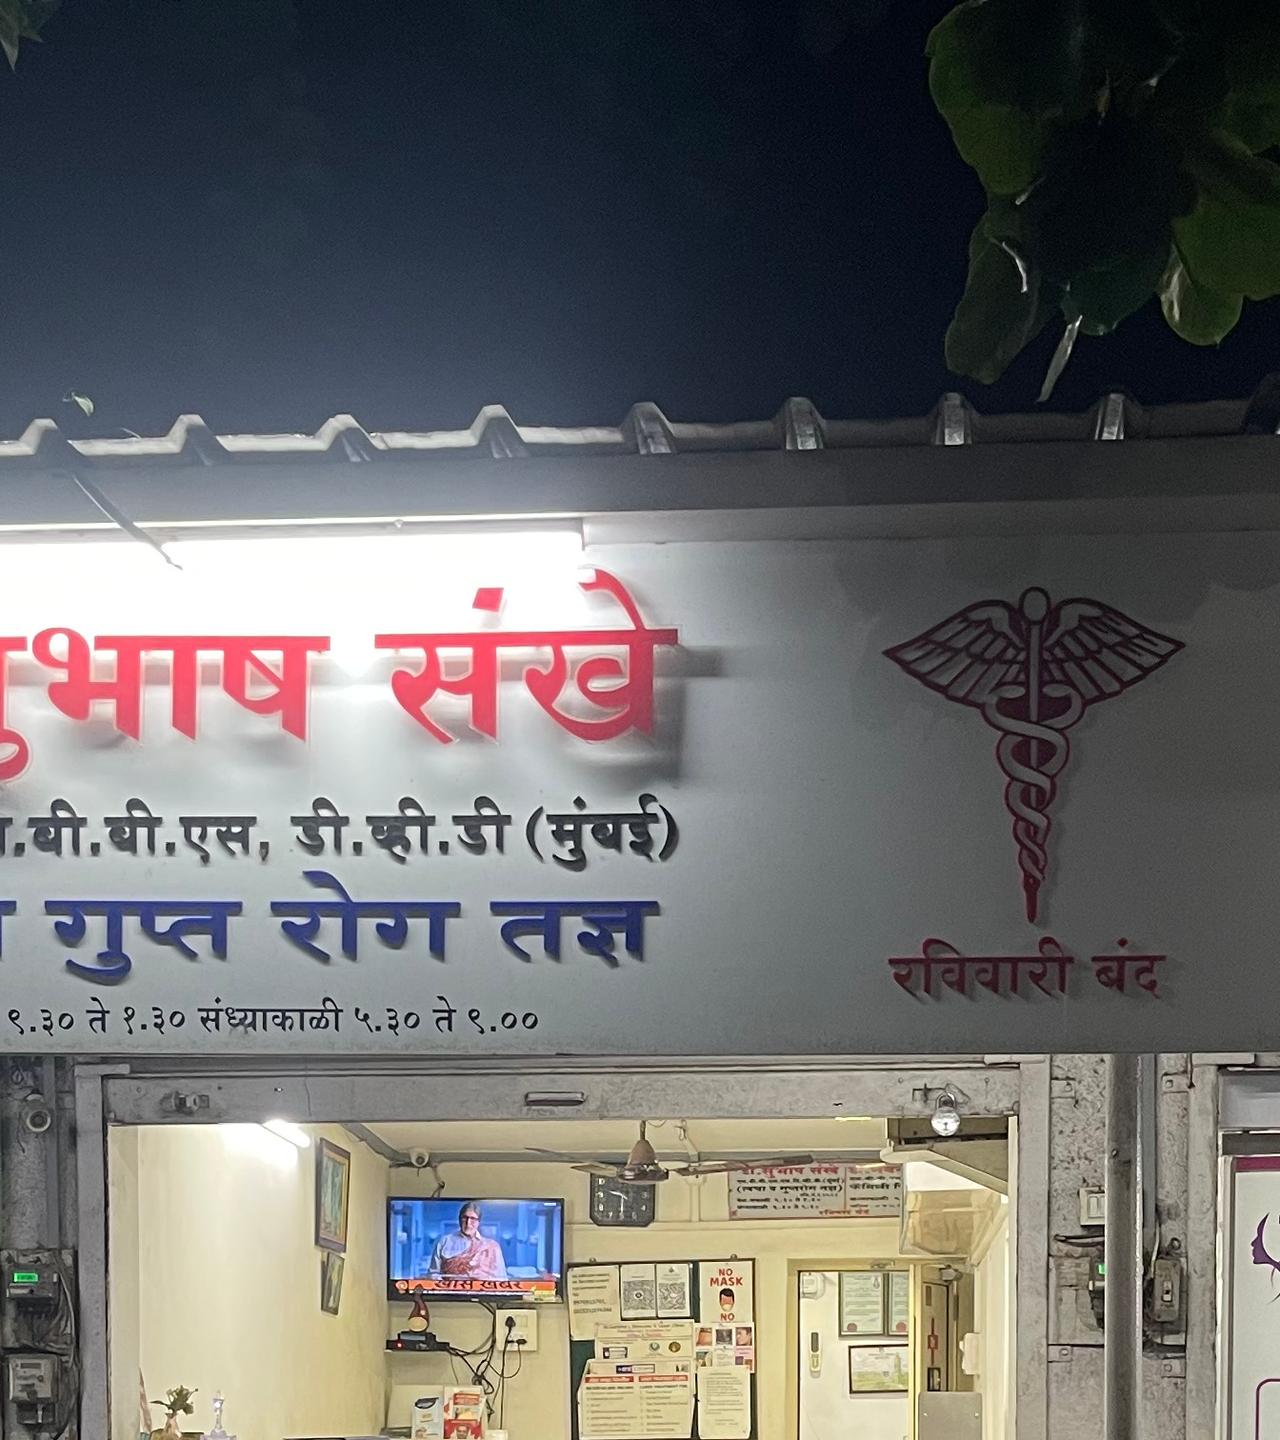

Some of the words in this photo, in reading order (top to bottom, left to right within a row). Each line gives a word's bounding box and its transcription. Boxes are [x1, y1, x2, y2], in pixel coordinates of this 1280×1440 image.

[375, 567, 679, 745] संखे
[525, 793, 679, 871] (मुंबई)
[44, 898, 242, 986] गुप्त
[270, 870, 461, 962] रोग
[490, 901, 660, 967] तज्ञ
[888, 938, 1074, 999] रविवारी
[1091, 938, 1167, 999] बंद
[86, 997, 110, 1034] ते
[198, 997, 344, 1033] संध्याकाळी
[433, 995, 458, 1032] ते
[710, 1277, 743, 1287] MASK
[718, 1268, 733, 1277] NO
[720, 1313, 735, 1321] NO
